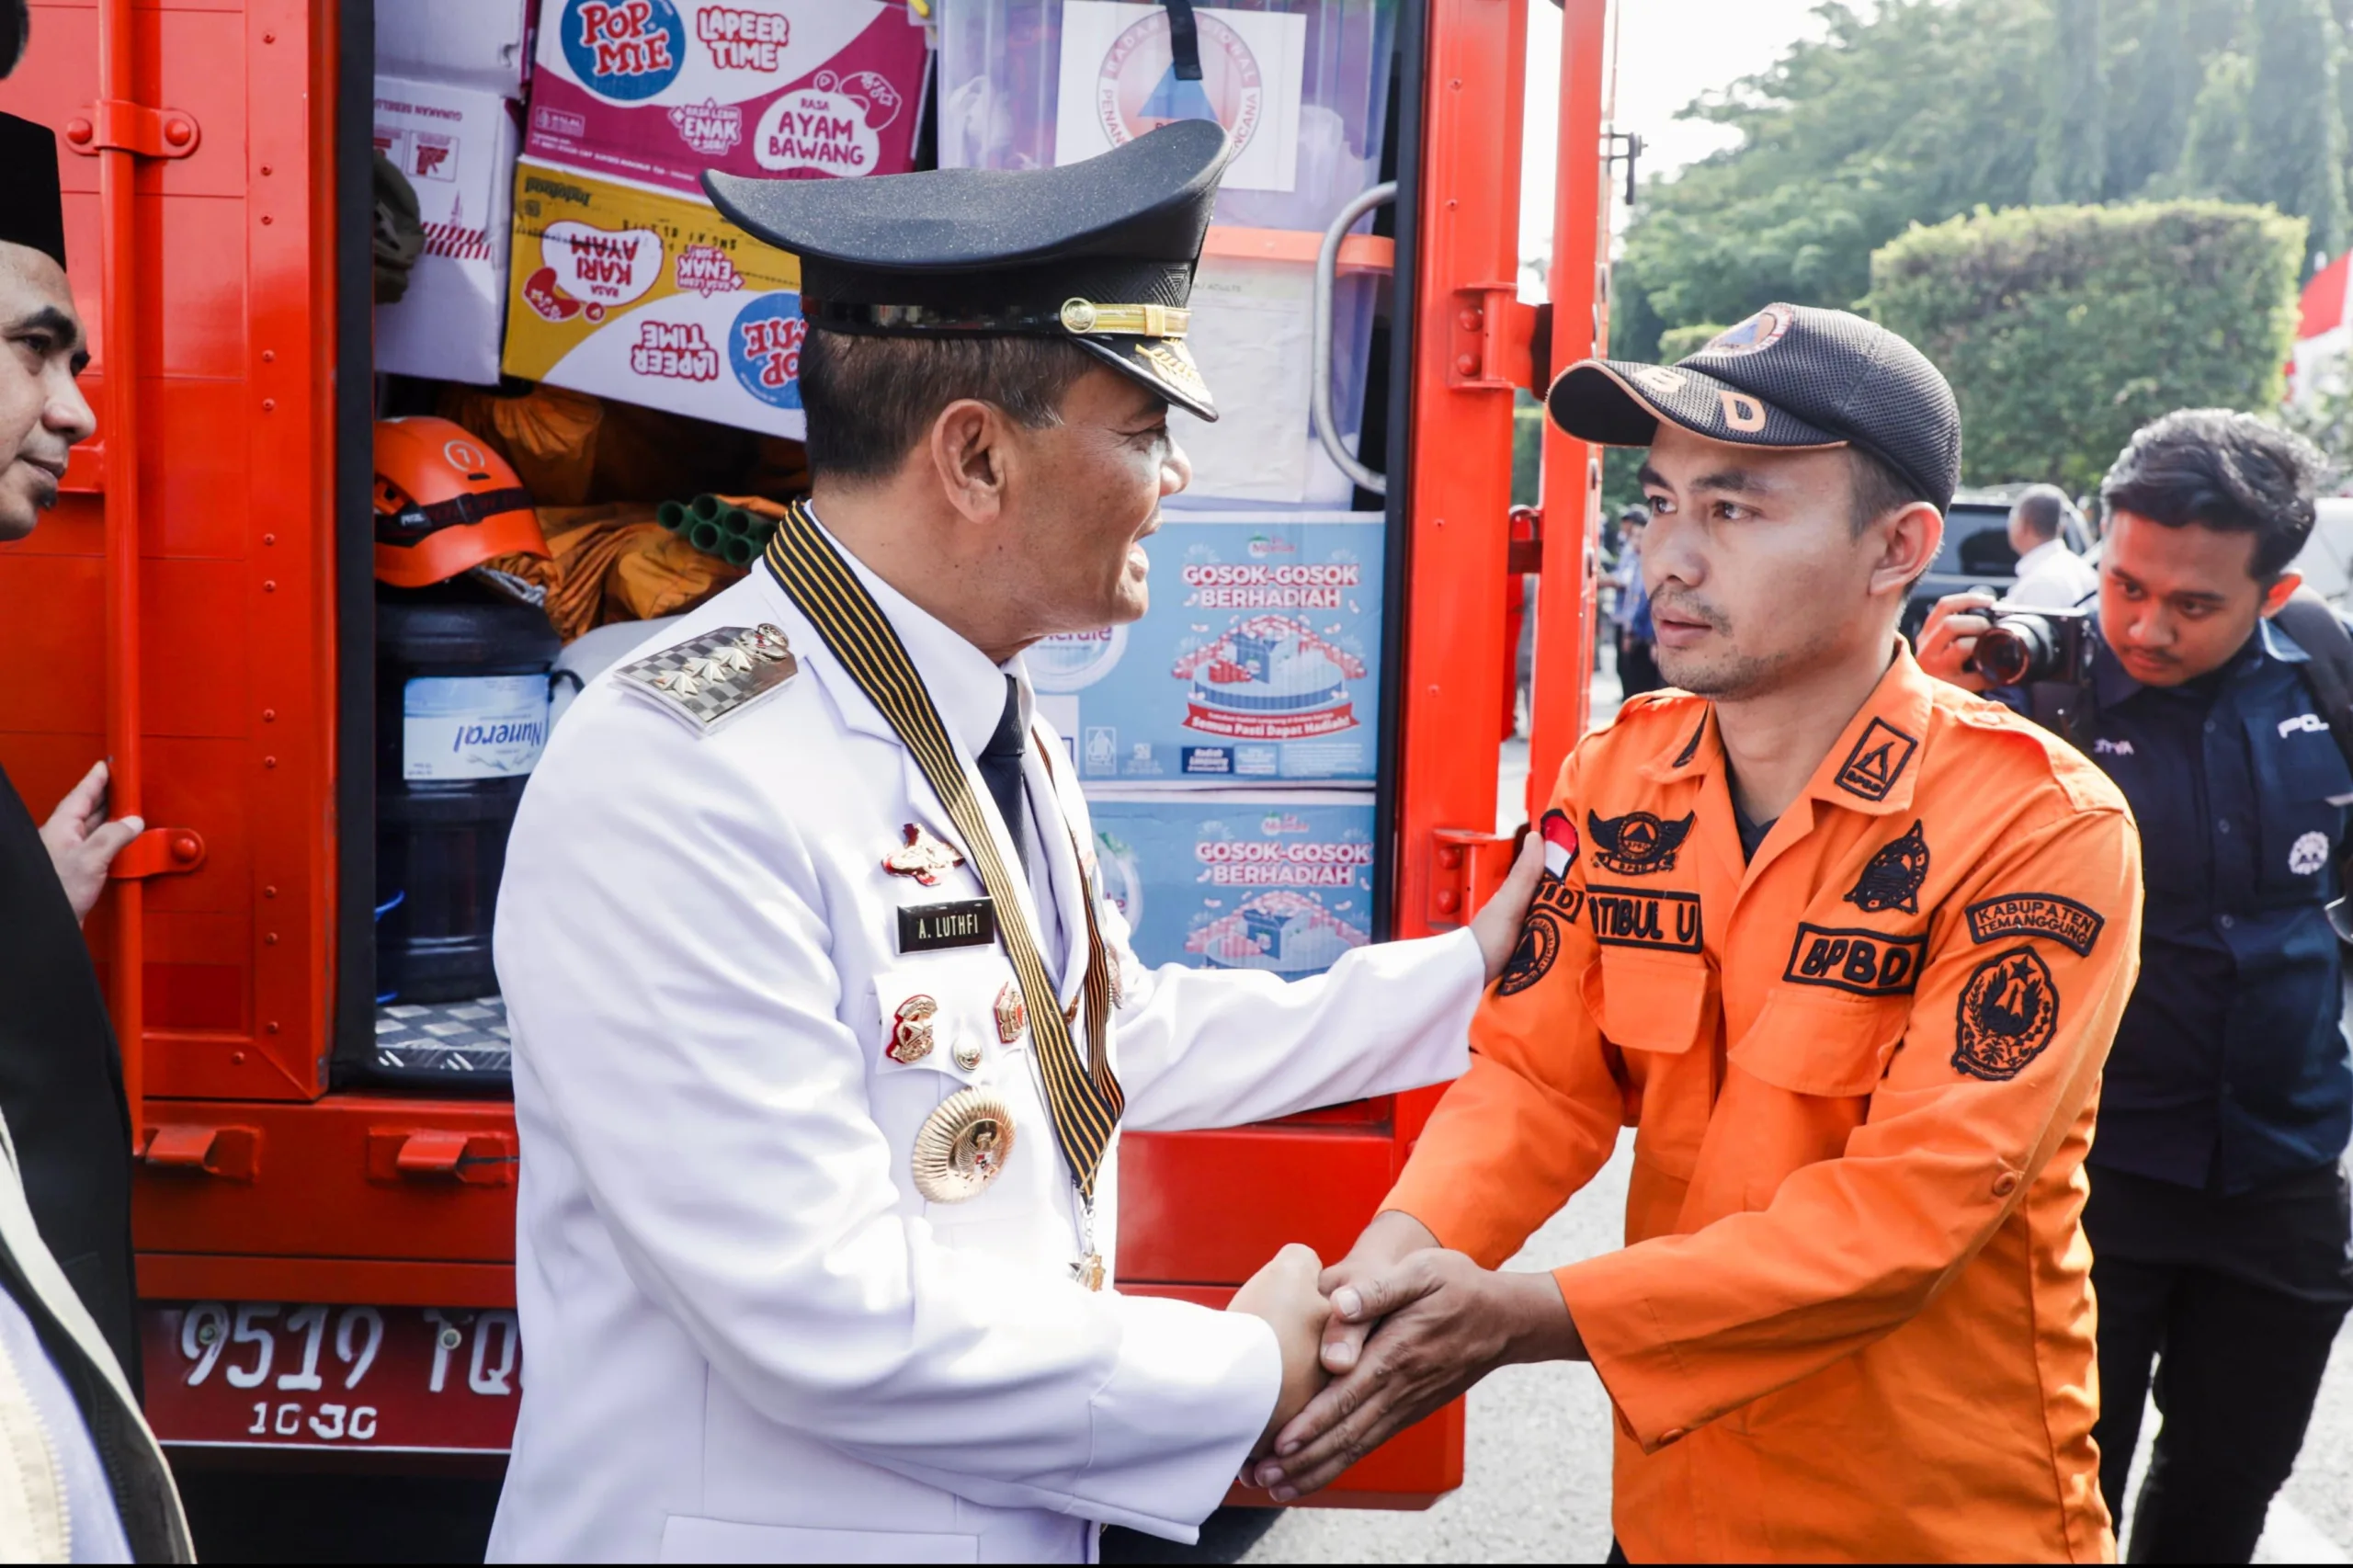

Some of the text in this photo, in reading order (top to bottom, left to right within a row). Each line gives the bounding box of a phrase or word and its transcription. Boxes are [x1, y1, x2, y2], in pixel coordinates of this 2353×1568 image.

[580, 2, 650, 45] POP
[699, 7, 789, 43] LAPEER
[596, 33, 671, 74] MIE
[710, 40, 778, 72] TIME
[801, 97, 829, 111] RASA
[684, 117, 739, 142] ENAK
[779, 111, 853, 142] AYAM
[768, 136, 864, 165] BAWANG
[570, 232, 638, 260] AYAM
[576, 256, 632, 286] KARI
[678, 256, 732, 280] ENAK
[640, 321, 707, 350] TIME
[631, 346, 719, 382] LAPEER
[763, 352, 800, 389] OP
[1182, 564, 1360, 586] GOSOK-GOSOK
[1199, 587, 1342, 609] BERHADIAH
[1196, 842, 1372, 864] GOSOK-GOSOK
[1212, 866, 1354, 886] BERHADIAH
[918, 914, 978, 939] A. LUTHFI
[1677, 903, 1696, 943] U
[1977, 901, 2094, 932] KABUPATEN
[1978, 915, 2089, 946] TEMANGGUNG
[1799, 938, 1915, 984] BPBD
[183, 1301, 384, 1391] 9519
